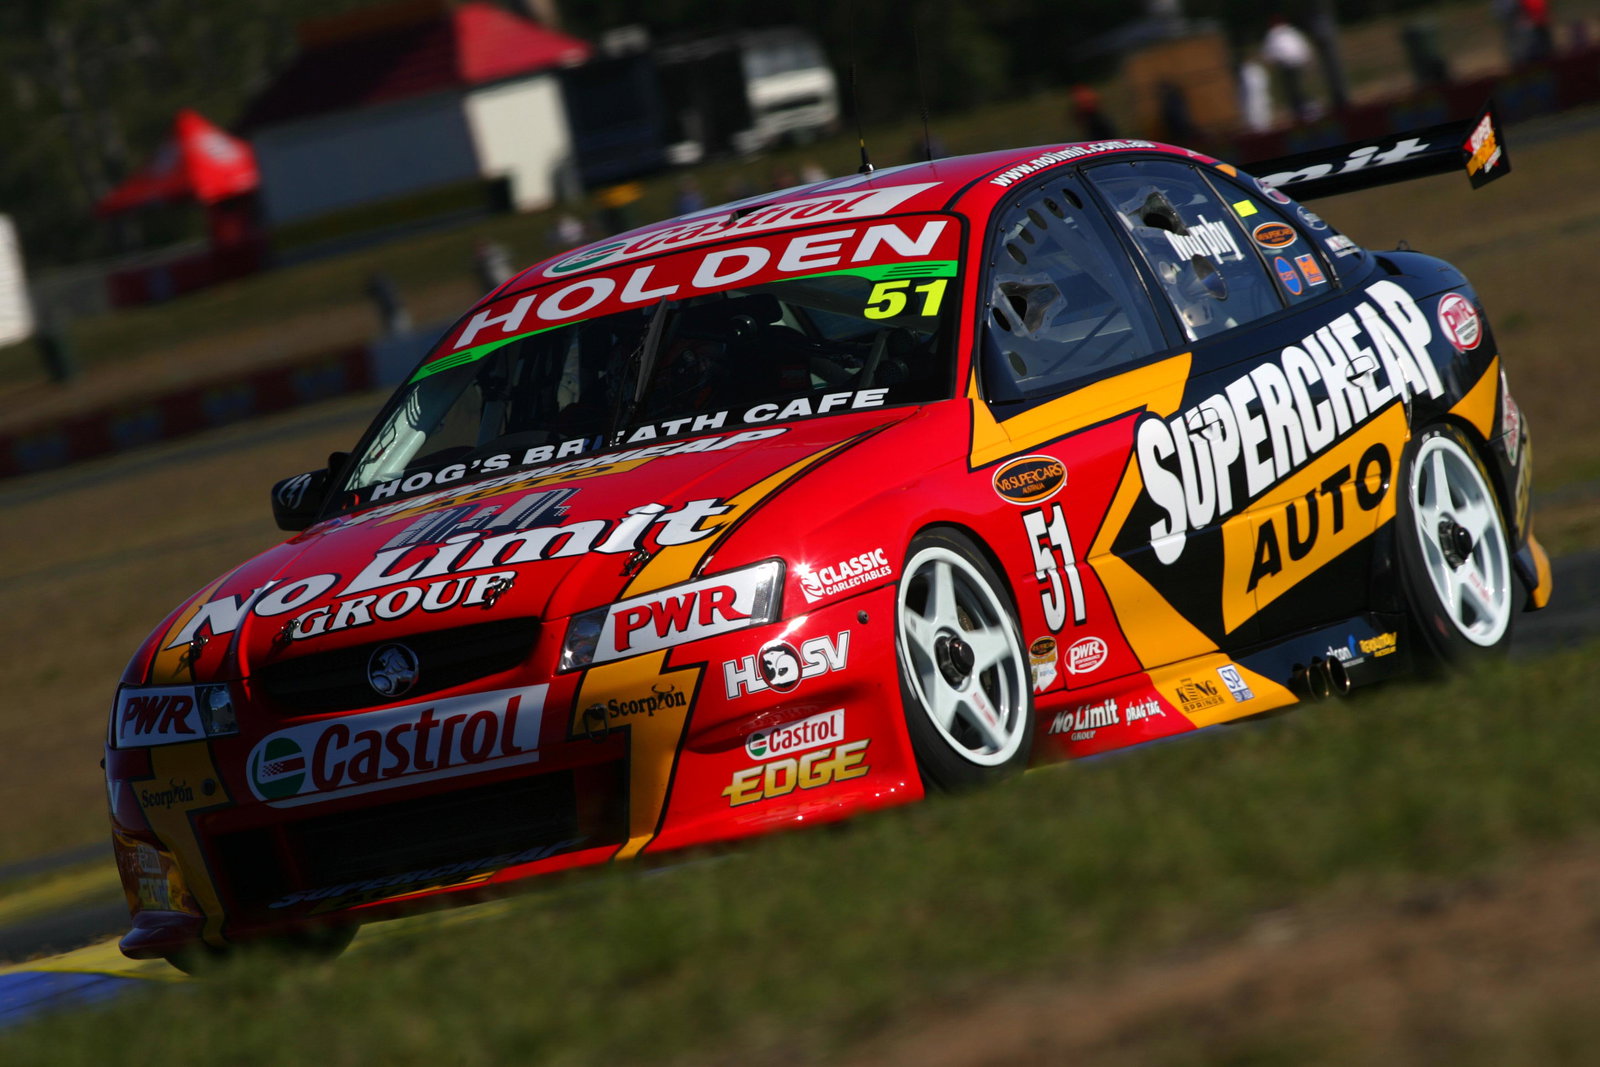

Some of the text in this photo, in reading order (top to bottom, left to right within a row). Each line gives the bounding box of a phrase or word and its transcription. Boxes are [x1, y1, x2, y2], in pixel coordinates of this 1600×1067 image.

[621, 189, 872, 257] Castrol
[453, 220, 948, 350] HOLDEN
[864, 278, 949, 320] 51
[370, 453, 511, 502] HOG'S
[742, 387, 890, 423] CAFE
[1137, 279, 1445, 566] SUPERCHEAP
[1009, 463, 1063, 489] SUPERCARS
[334, 497, 735, 598] Limit
[1246, 442, 1393, 594] AUTO
[820, 548, 889, 585] CLASSIC
[826, 565, 893, 596] CARLECTABLES
[1021, 502, 1087, 634] 51
[292, 570, 517, 641] GROUP
[612, 584, 753, 652] PWR
[1070, 640, 1105, 675] PWR
[120, 695, 198, 740] PWR
[607, 685, 688, 720] Scorpion
[769, 714, 838, 753] Castrol
[1071, 729, 1097, 742] GROUP
[1075, 698, 1120, 731] Limit
[311, 694, 523, 791] Castrol
[721, 738, 873, 808] EDGE
